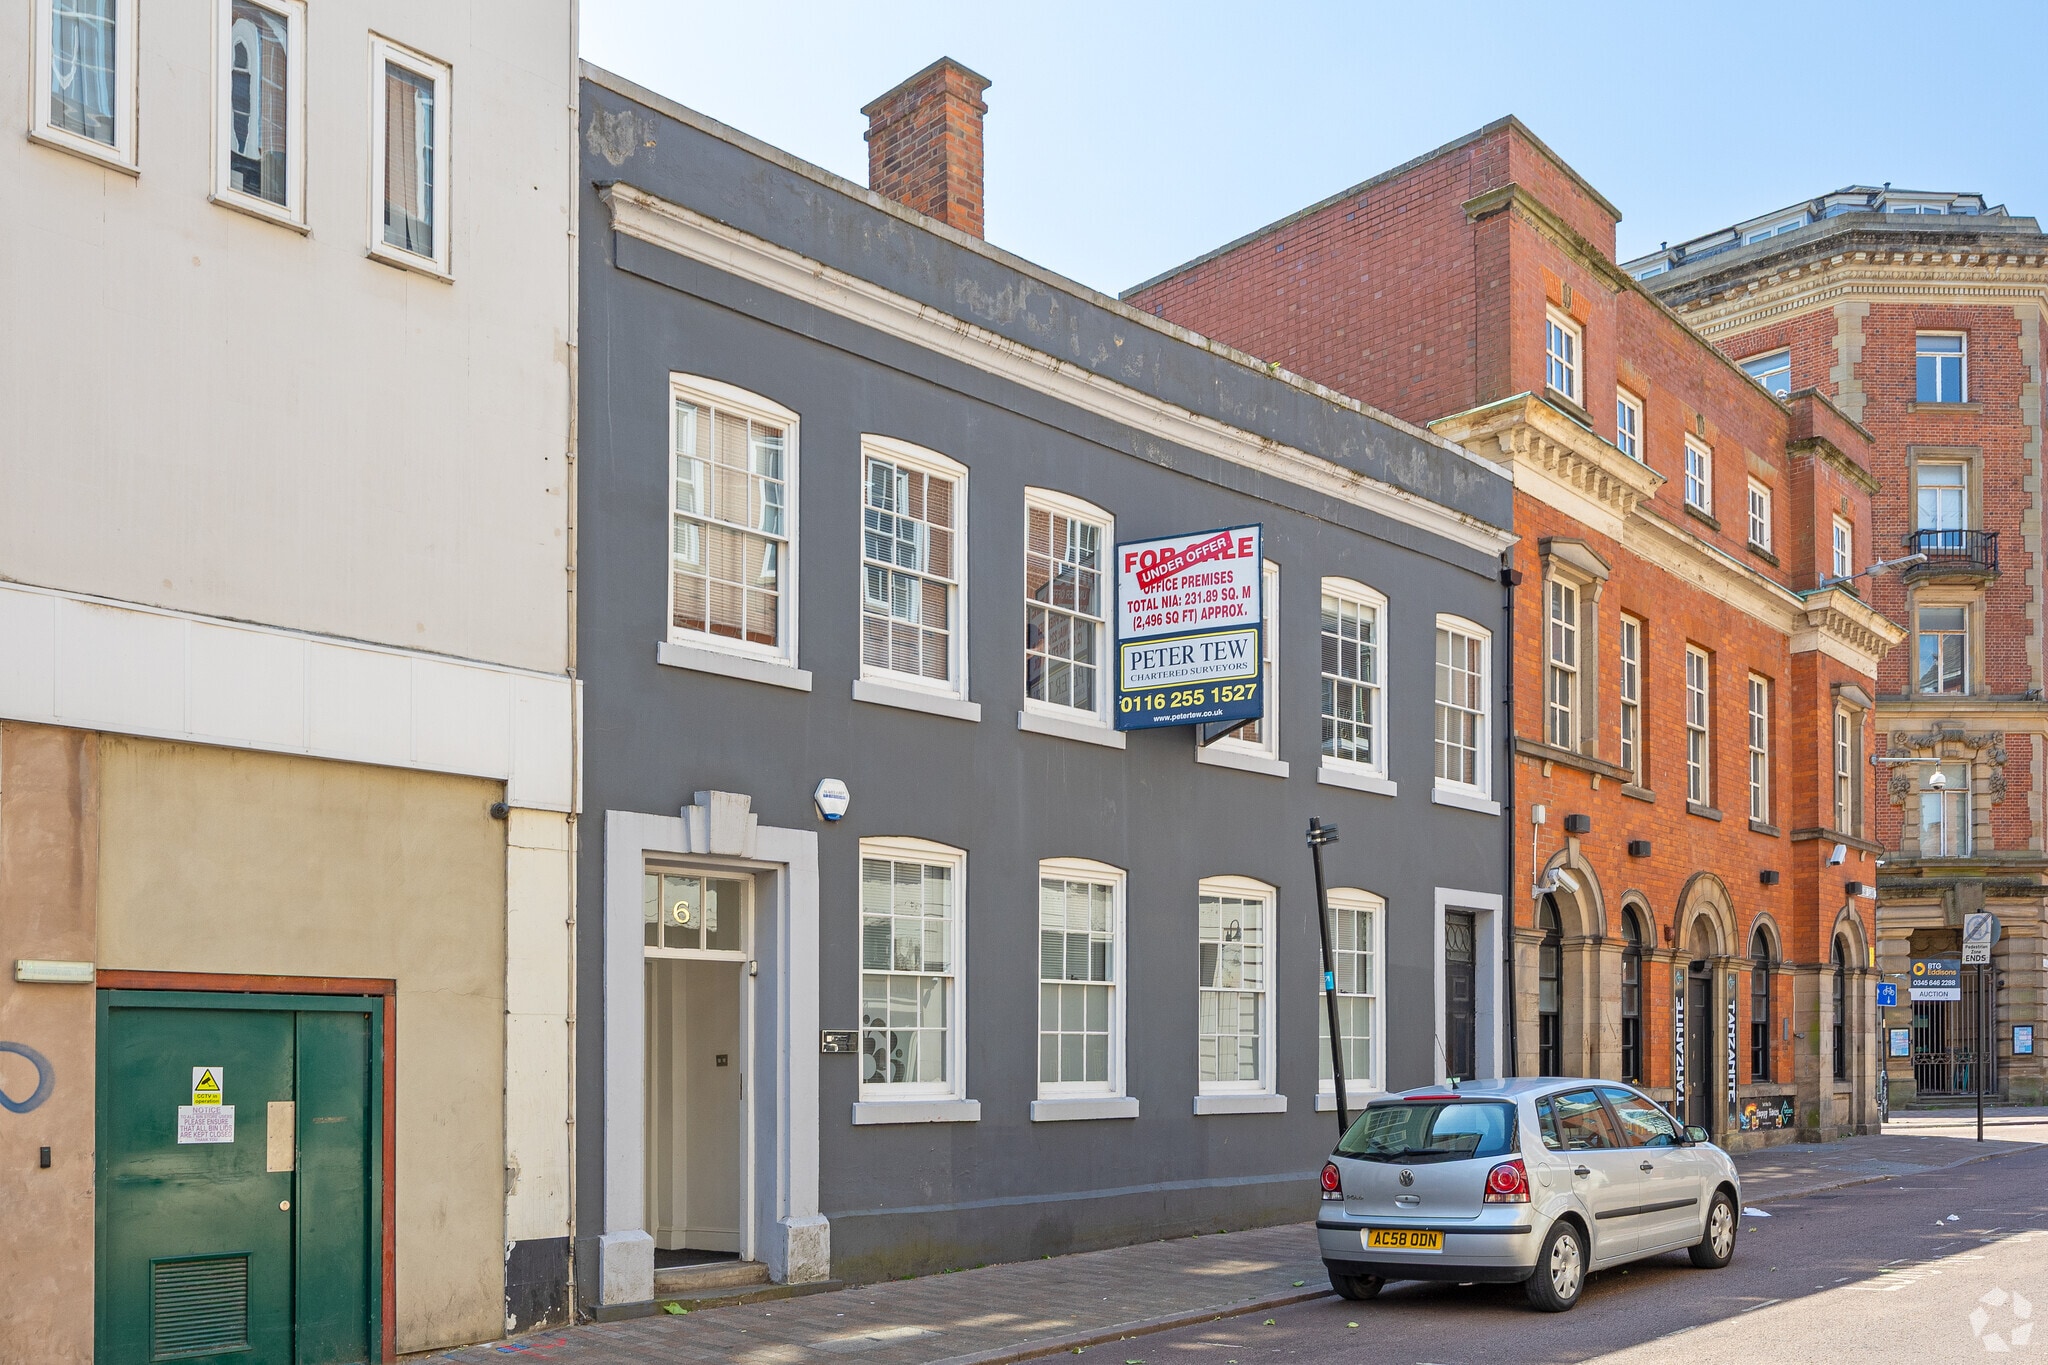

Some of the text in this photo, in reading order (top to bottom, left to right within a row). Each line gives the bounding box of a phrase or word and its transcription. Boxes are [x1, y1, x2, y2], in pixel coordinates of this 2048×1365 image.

[1142, 537, 1227, 582] UNDER OFFER
[1181, 570, 1233, 589] PREMISES
[1127, 585, 1251, 613] TOTAL NIA: 231.89 SQ. M
[1133, 603, 1247, 631] (2,496 SQ FT) APPROX.
[1131, 639, 1248, 671] PETER TEW
[1130, 662, 1248, 682] CHARTERED SURVEYORS
[1121, 683, 1257, 713] 0116 255 1527
[1153, 708, 1223, 722] www.petertew.co.uk
[673, 900, 690, 924] 6
[1676, 997, 1684, 1106] TANZANITE
[1728, 1000, 1736, 1103] TANZANITE
[1374, 1231, 1437, 1248] AC58 ODN
